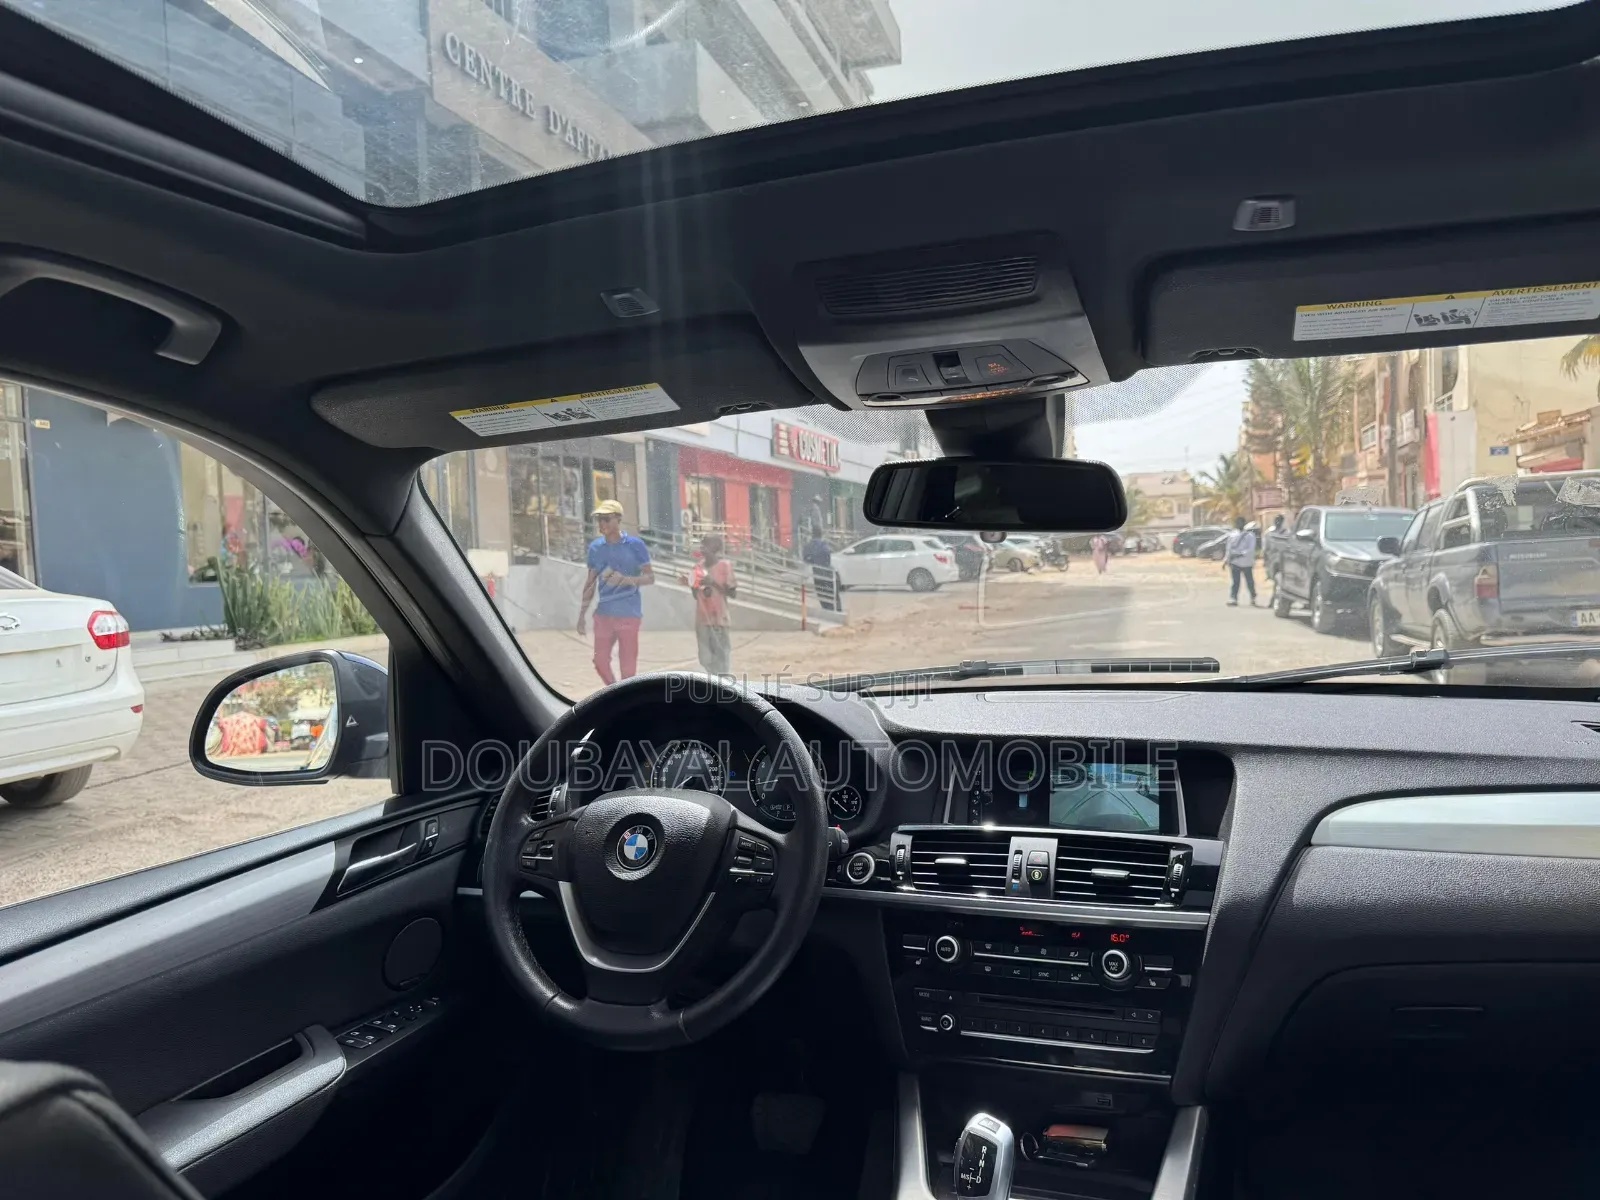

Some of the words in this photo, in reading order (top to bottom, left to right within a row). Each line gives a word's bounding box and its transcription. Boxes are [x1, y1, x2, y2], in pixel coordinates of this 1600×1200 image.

[445, 32, 536, 120] CENTRE
[1491, 282, 1599, 297] AVERTISSEMENT
[1326, 300, 1383, 310] WARNING
[469, 405, 510, 414] WARNING
[623, 826, 655, 842] BMW
[981, 1145, 988, 1155] R
[978, 1159, 985, 1168] N
[975, 1175, 982, 1184] D
